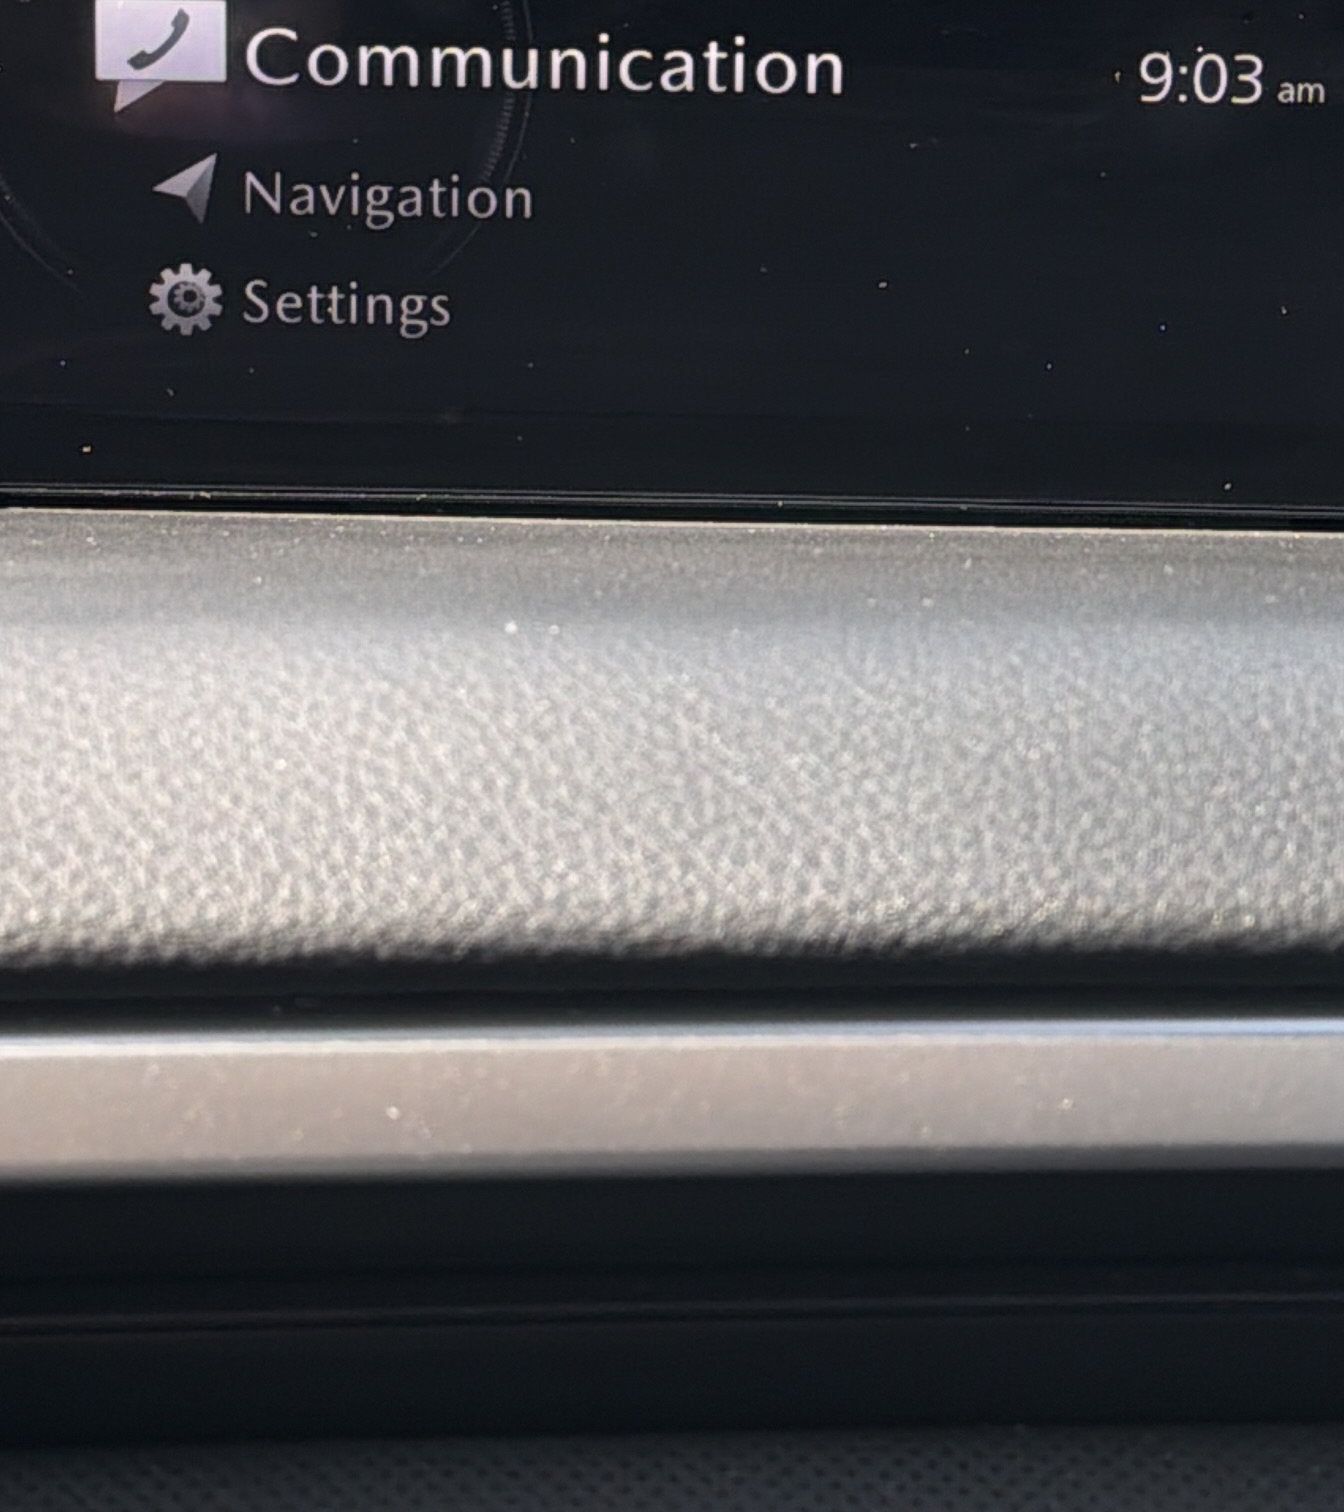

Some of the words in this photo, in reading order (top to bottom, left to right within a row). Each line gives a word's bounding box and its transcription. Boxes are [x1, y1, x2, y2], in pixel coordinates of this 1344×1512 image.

[246, 27, 844, 97] Communication
[1140, 52, 1264, 104] 9:03
[1277, 80, 1326, 105] am
[245, 172, 532, 229] Navigation
[243, 279, 451, 340] Settings
